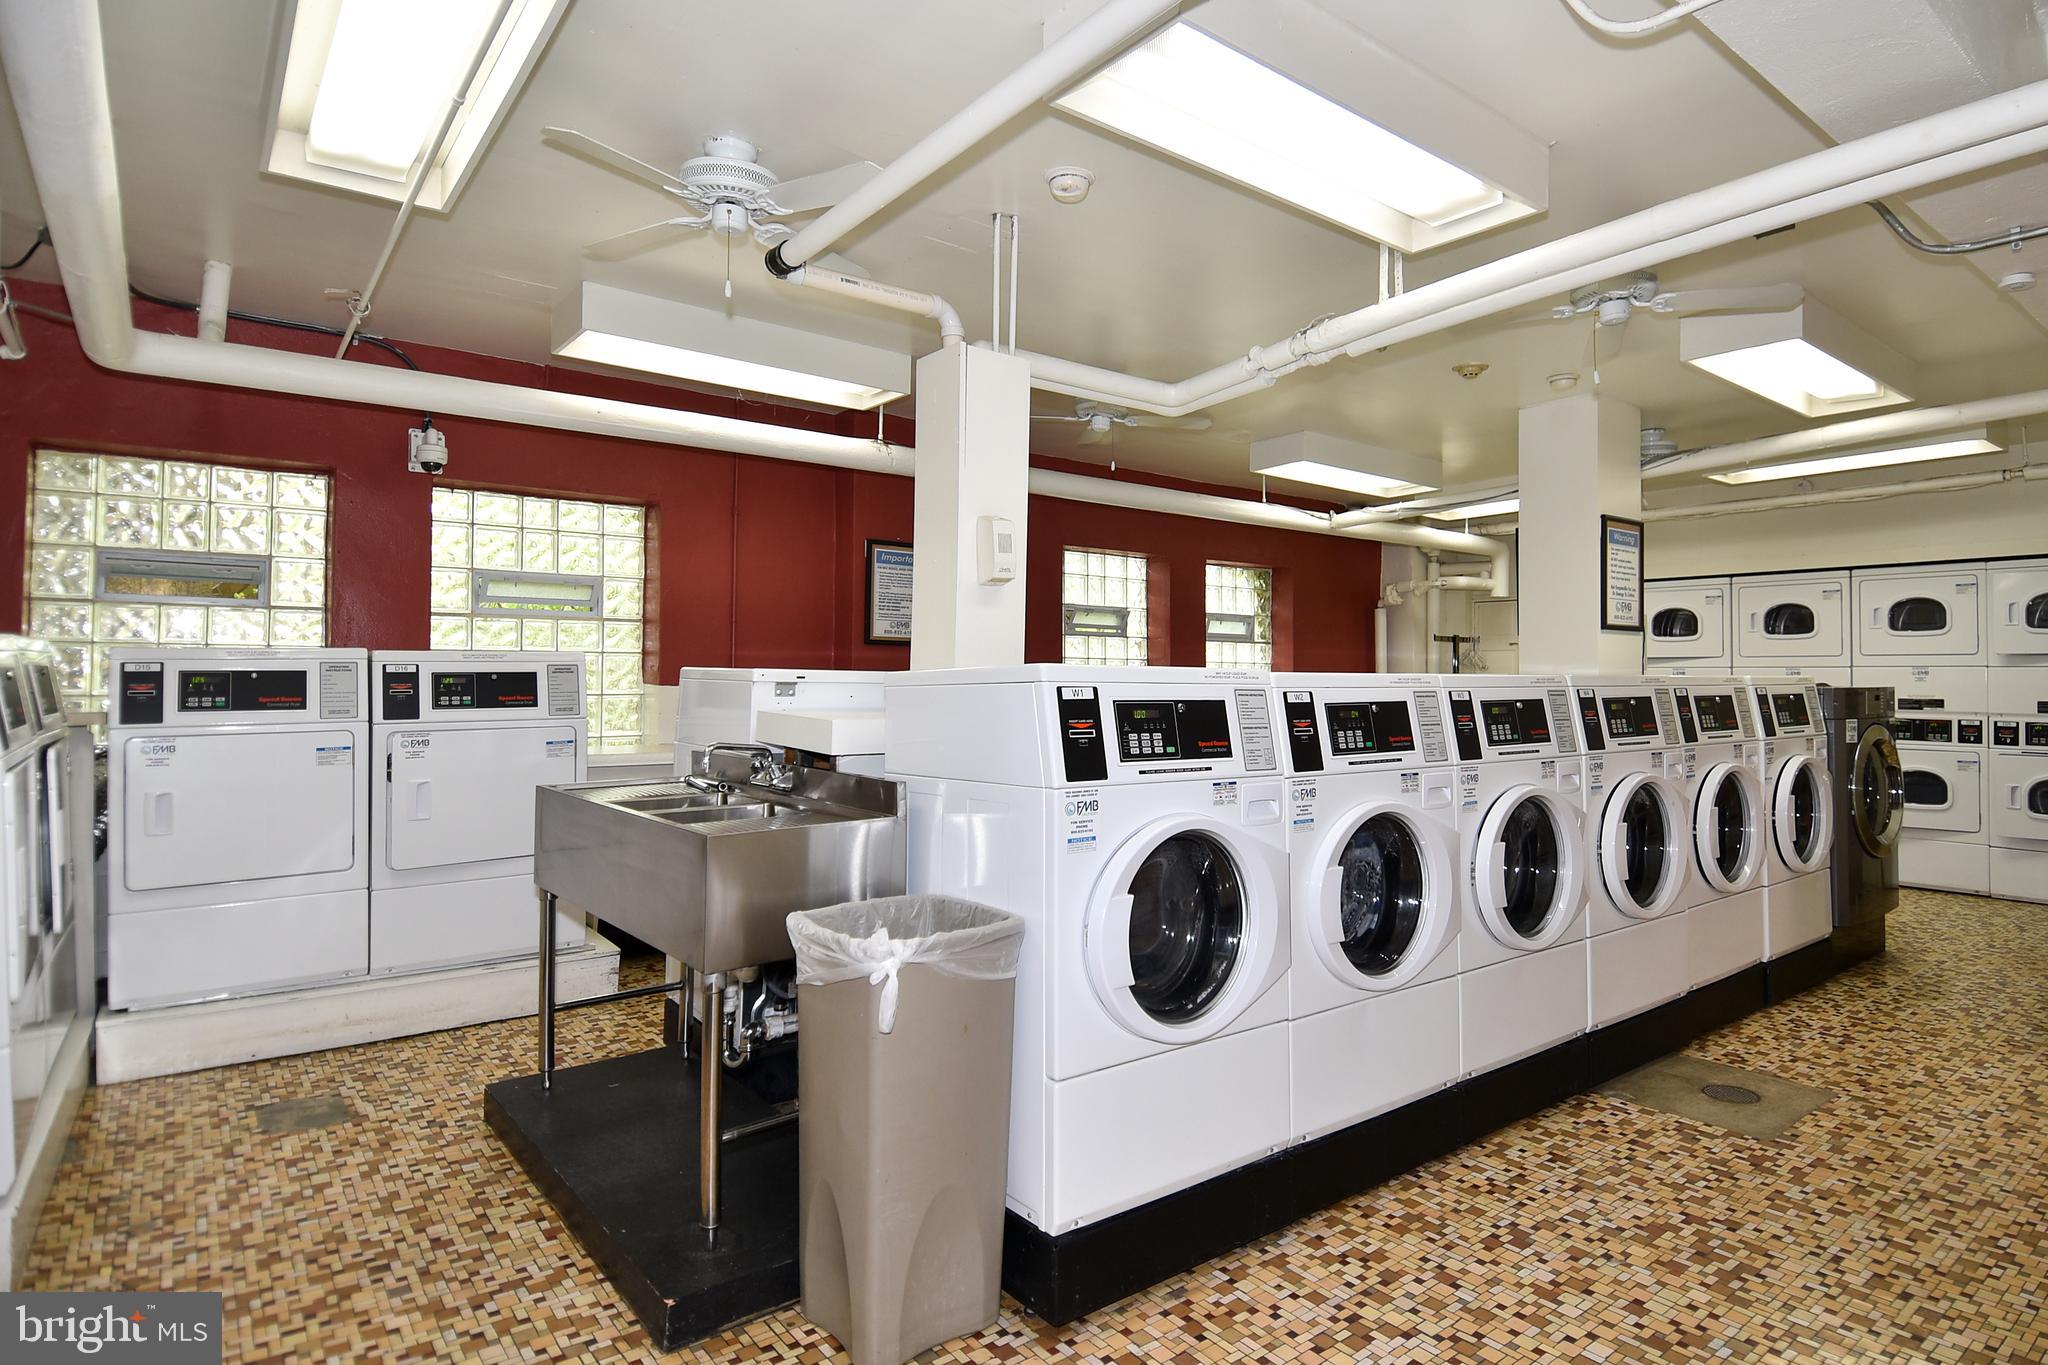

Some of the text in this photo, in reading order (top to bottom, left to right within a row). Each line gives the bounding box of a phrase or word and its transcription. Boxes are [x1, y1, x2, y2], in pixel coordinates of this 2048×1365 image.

[1613, 531, 1635, 545] Warning
[1071, 689, 1084, 697] W1
[1294, 693, 1304, 701] W2
[259, 696, 280, 704] Speed
[410, 739, 430, 749] FMB
[152, 745, 176, 756] FMB
[1300, 788, 1317, 801] FMB
[1077, 800, 1099, 816] FMB
